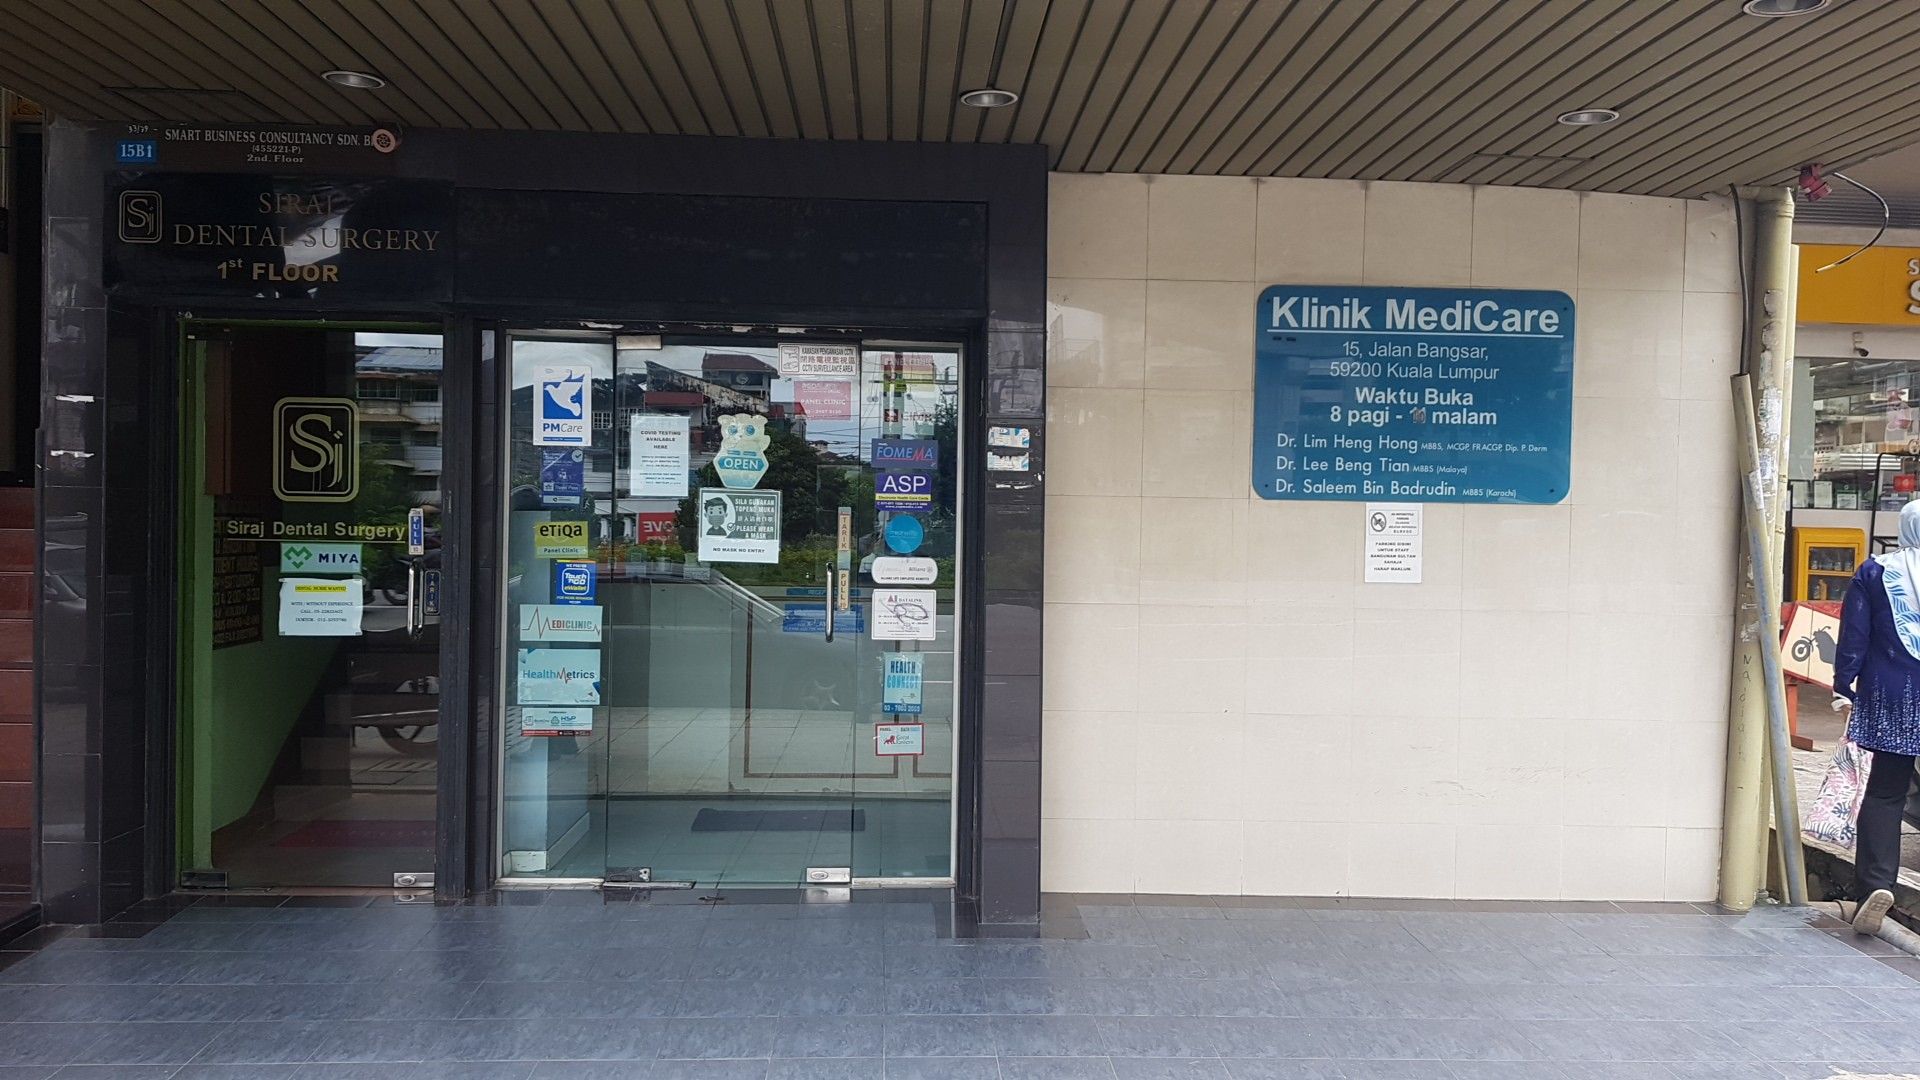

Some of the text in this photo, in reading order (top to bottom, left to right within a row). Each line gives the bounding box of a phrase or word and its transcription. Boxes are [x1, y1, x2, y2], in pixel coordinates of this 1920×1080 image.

[165, 129, 201, 141] SMART
[204, 130, 256, 143] BUSINESS
[259, 132, 334, 145] CONSULTANCY
[337, 134, 361, 146] SDN.
[274, 155, 305, 163] Floor
[259, 192, 332, 215] SIRAJ
[174, 224, 441, 252] DENTAL SURGERY
[217, 257, 339, 283] 1st FLOOR
[1271, 296, 1560, 334] Klinik MediCare
[1342, 341, 1489, 362] 15, Jalan Bangsar,
[1329, 362, 1500, 384] 59200 Kuala Lumpur
[1355, 386, 1474, 407] Waktu Buka
[543, 422, 583, 433] PMCare
[1330, 406, 1341, 423] 8
[1347, 406, 1390, 428] pagi
[1432, 408, 1497, 426] malam
[877, 446, 933, 461] FOMEMA
[1276, 433, 1297, 449] Dr.
[1303, 434, 1327, 449] Lim
[1333, 435, 1373, 453] Heng
[1378, 436, 1418, 454] Hong
[1420, 442, 1444, 452] MBBS,
[1505, 444, 1519, 453] Dip.
[1528, 445, 1548, 453] Derm
[724, 458, 759, 470] OPEN
[1276, 456, 1468, 476] Dr. Lee Beng Tian MBBS (Malaya)
[883, 475, 926, 493] ASP
[1275, 479, 1517, 498] Dr. Saleem Bin Badrudin MBBS (Karachi)
[227, 520, 408, 541] Siraj Dental Surgery
[412, 516, 420, 546] PULL
[318, 553, 359, 564] MIYA
[429, 573, 437, 607] TARIK
[890, 661, 916, 673] HEALTH
[887, 675, 919, 689] CONNECT
